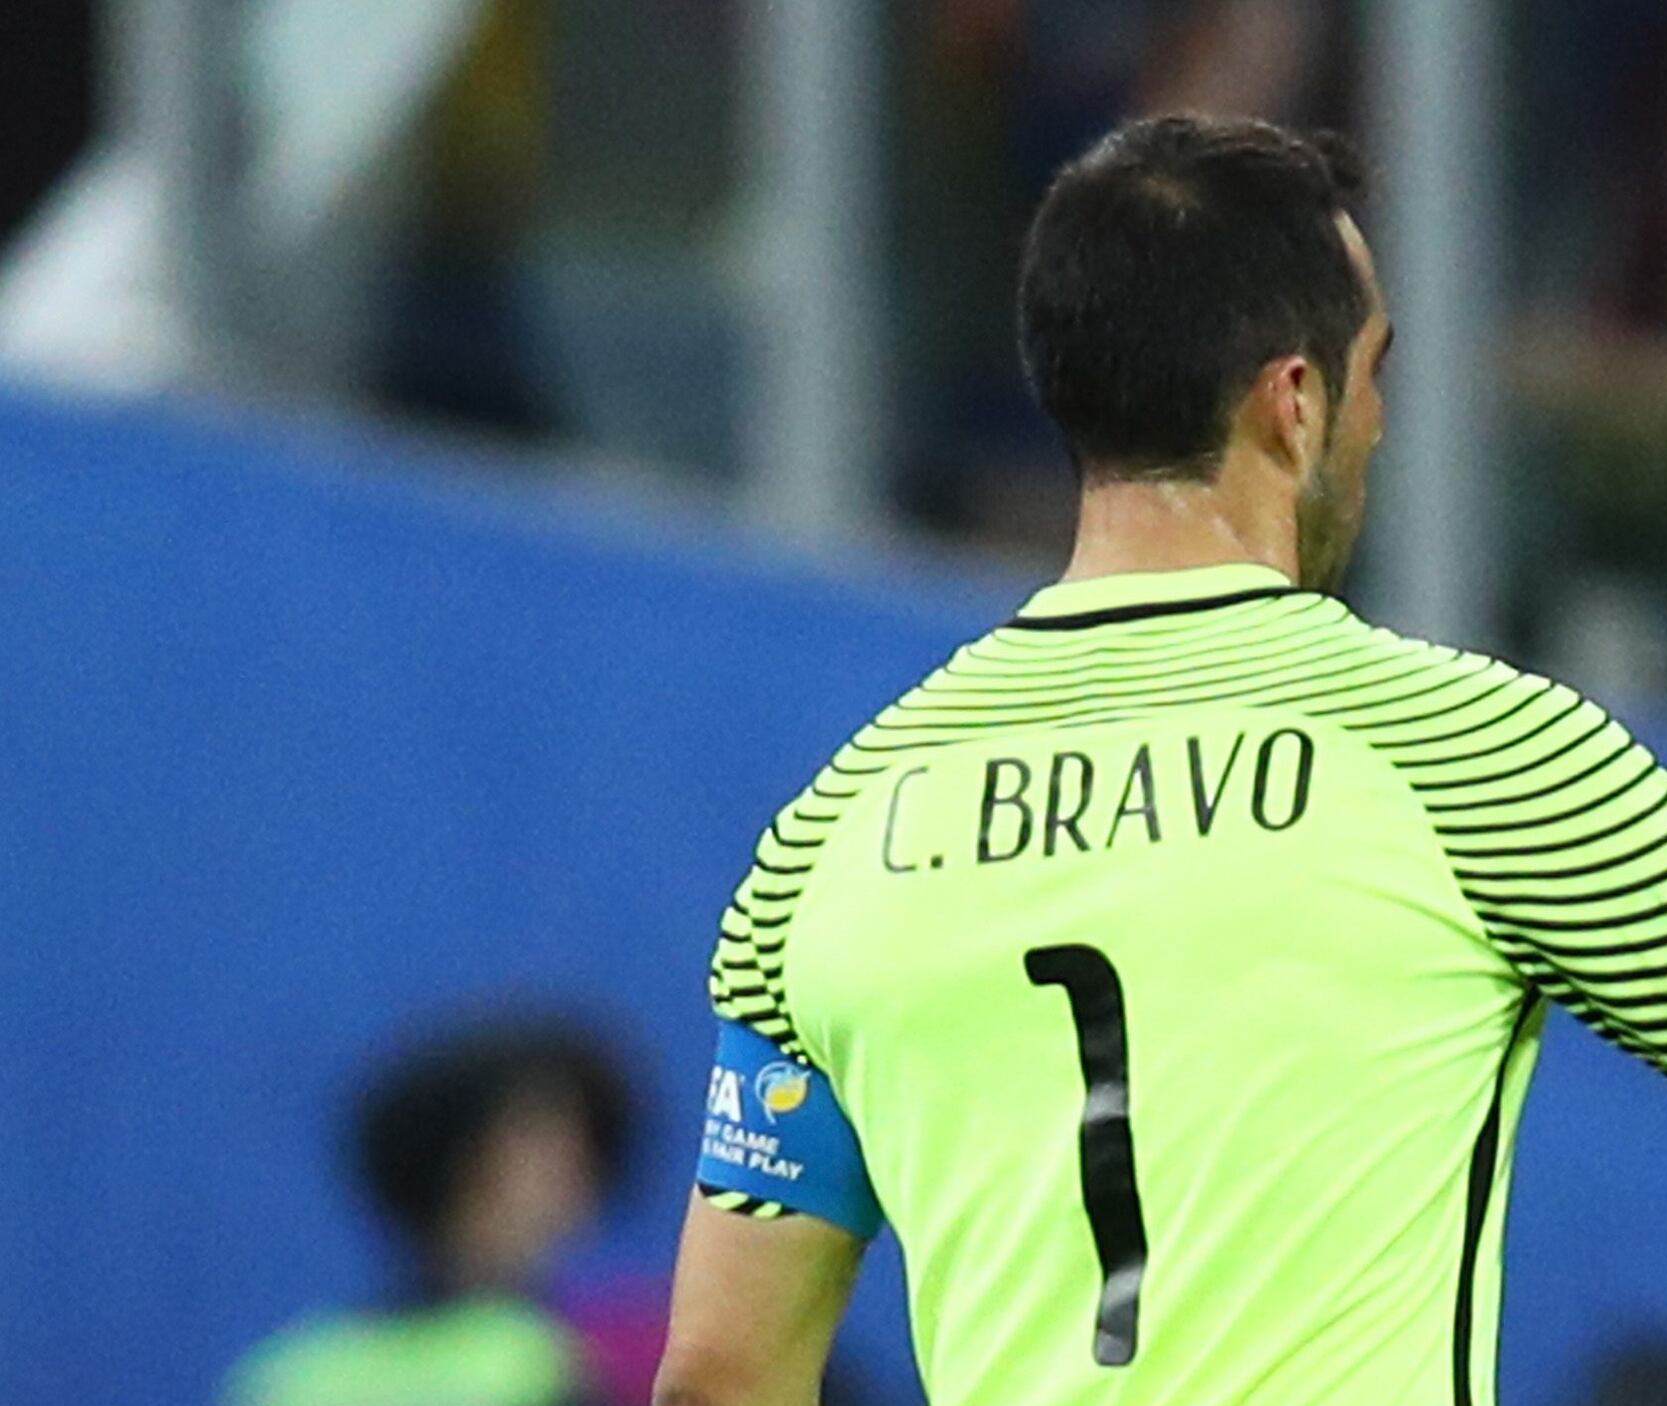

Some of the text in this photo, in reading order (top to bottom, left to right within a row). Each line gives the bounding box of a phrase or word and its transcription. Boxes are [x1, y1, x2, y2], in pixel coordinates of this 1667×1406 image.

[883, 728, 1315, 873] C. BRAVO
[748, 1151, 805, 1182] PLAY
[1024, 943, 1148, 1366] 1
